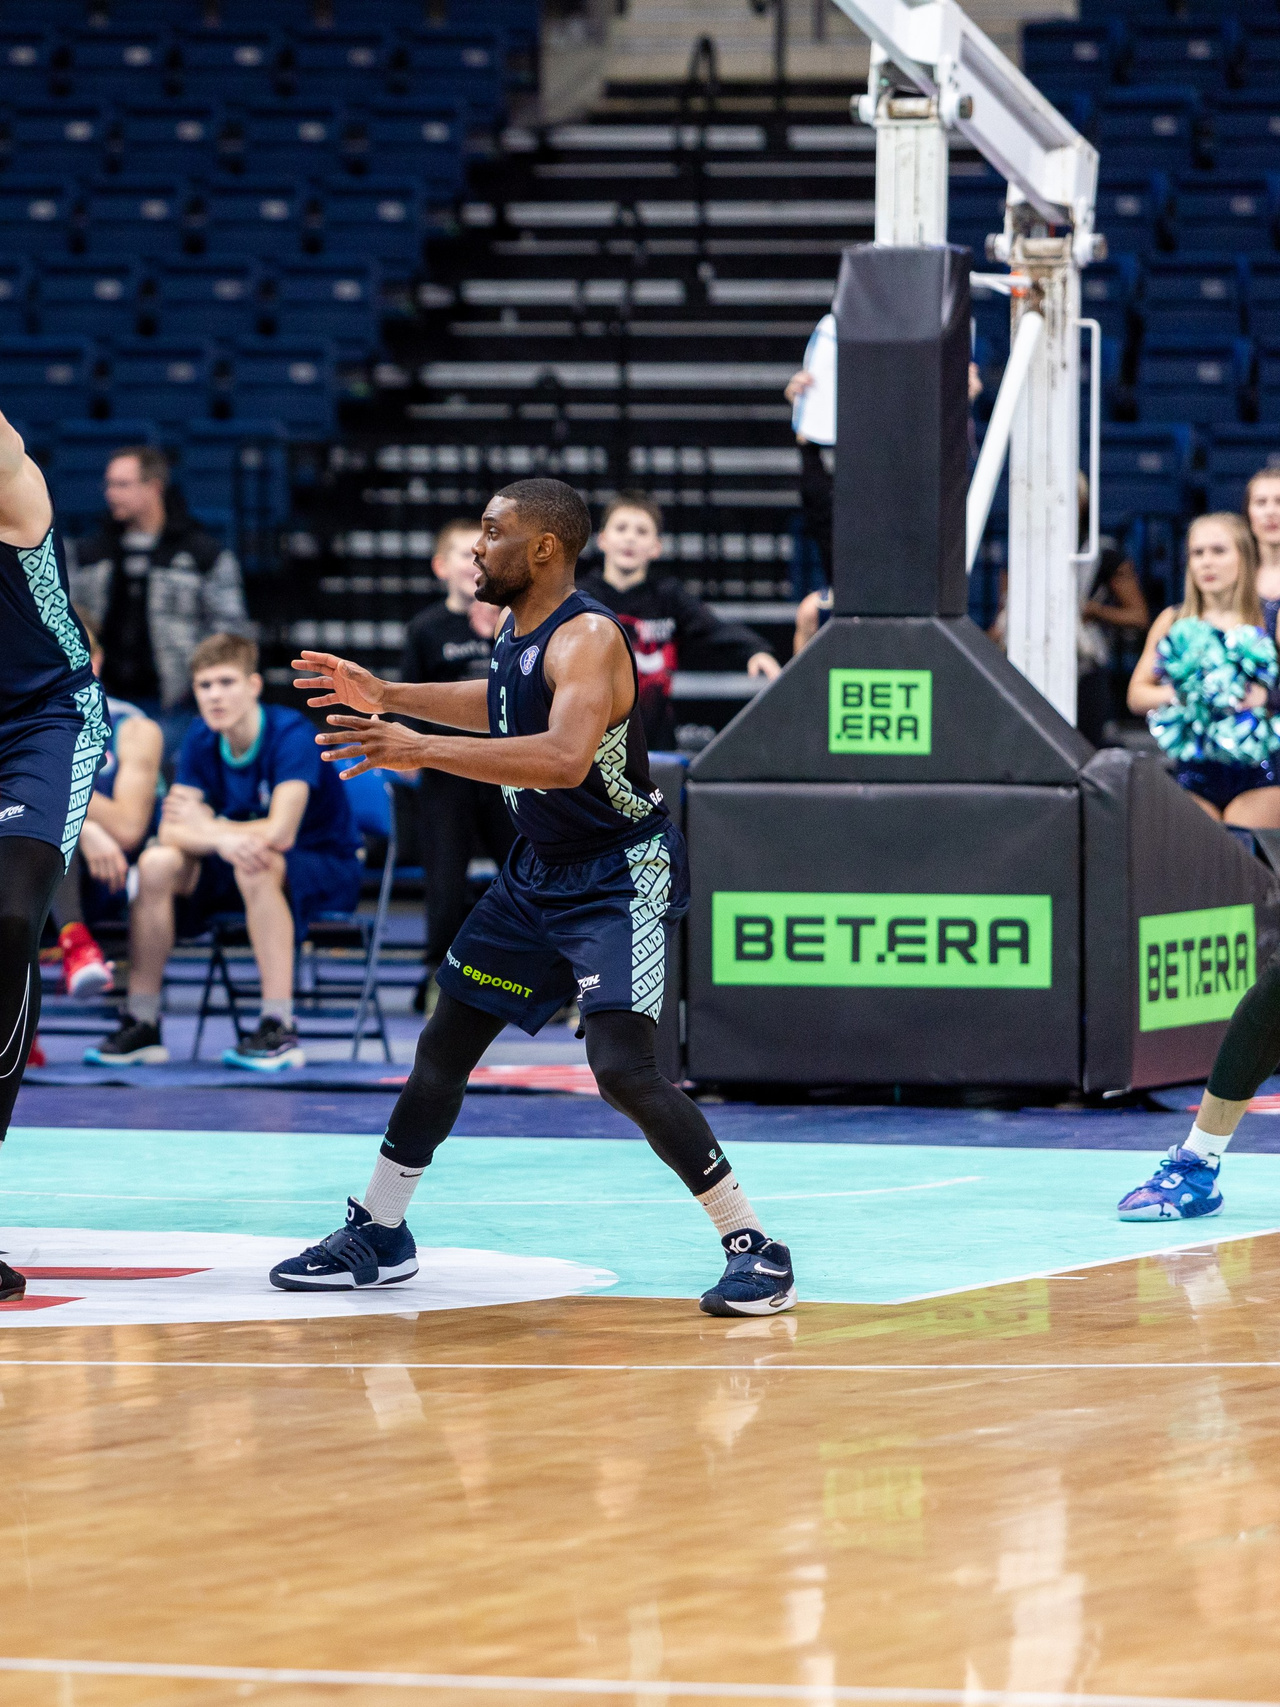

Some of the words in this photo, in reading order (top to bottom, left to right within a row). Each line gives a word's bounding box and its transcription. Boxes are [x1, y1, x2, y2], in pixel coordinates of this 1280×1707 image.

[499, 686, 508, 734] 3
[842, 682, 919, 709] BET
[462, 965, 533, 999] евроопт
